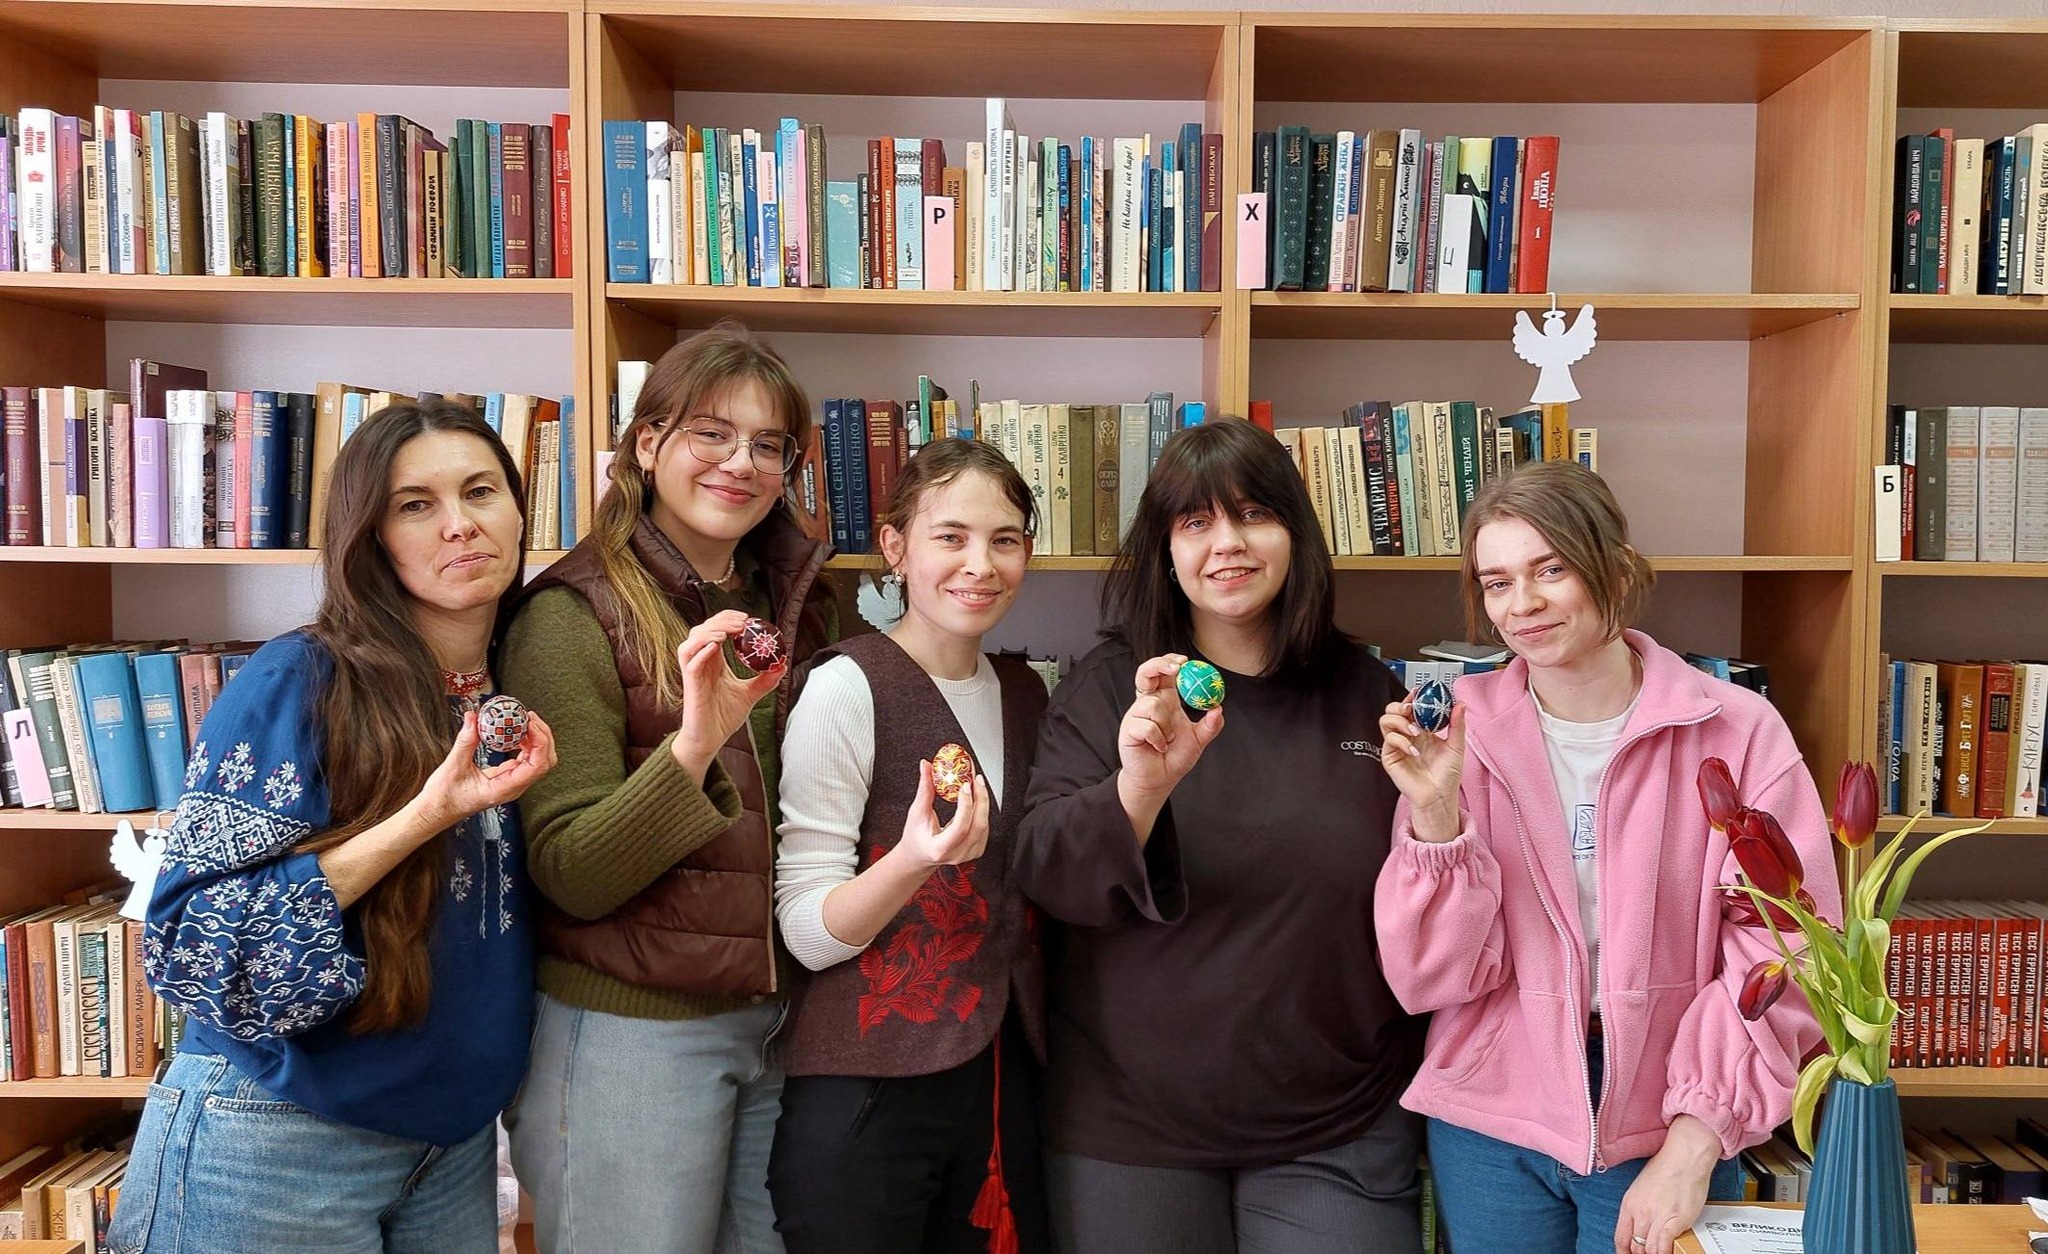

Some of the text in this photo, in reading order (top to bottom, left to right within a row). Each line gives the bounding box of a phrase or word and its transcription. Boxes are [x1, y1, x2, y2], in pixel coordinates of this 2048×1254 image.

[268, 140, 281, 205] КОВІНЬКА
[987, 128, 998, 198] САМОТНІСТЬ ПРОРОКА
[1208, 145, 1216, 186] РЯБОКЛЯЧ
[1912, 150, 1920, 162] НІЧ
[1335, 141, 1349, 223] СПРАВЖНЯ ЖІНКА
[1399, 166, 1411, 201] Химко
[1531, 180, 1540, 200] Іван
[2004, 166, 2012, 200] АЗАЗЕЛЬ
[298, 196, 308, 263] Андрій Кокотюха
[934, 208, 945, 224] Р
[1245, 203, 1259, 221] Х
[886, 232, 893, 241] ЗА
[1443, 247, 1454, 267] Ц
[1939, 245, 1947, 269] МАРК
[90, 407, 100, 480] ГРИГОРІЙ КОСИНКА
[1033, 424, 1043, 463] СКЛЯРЕНКО
[1057, 425, 1067, 465] СКЛЯРЕНКО
[830, 423, 846, 524] ІВАН СЕНЧЕНКО
[850, 422, 864, 524] ІВАН СЕНЧЕНКО
[1034, 468, 1040, 481] 3
[1058, 467, 1064, 479] 4
[1462, 437, 1474, 502] ІВАН ЧЕНДЕЙ
[1883, 476, 1894, 493] Б
[1369, 467, 1390, 545] В. ЧЕМЕРИС
[1388, 479, 1400, 522] ЧЕМЕРИС
[1392, 525, 1401, 535] В.
[192, 685, 203, 725] ПОЛТАВА
[15, 720, 31, 739] Л
[2022, 722, 2040, 770] КАКТУС
[76, 744, 84, 756] ДО
[1891, 740, 1902, 782] ГОЛОД
[60, 936, 70, 962] ЩИТИ
[111, 941, 121, 980] ПОЛІССЯ
[1907, 932, 1917, 953] ТЕСС
[1952, 932, 1961, 952] ТЕСС
[1963, 932, 1973, 952] ТЕСС
[1890, 934, 1902, 997] ТЕСС ҐЕРРІТСЕН
[1905, 955, 1917, 996] ҐЕРРІТСЕН
[1949, 953, 1961, 995] ҐЕРРІТСЕН
[1960, 953, 1973, 995] ҐЕРРІТСЕН
[1979, 933, 1991, 996] ТЕСС ҐЕРРІТСЕН
[1997, 933, 2009, 997] ТЕСС ҐЕРРІТСЕН
[2010, 931, 2022, 995] ТЕСС ҐЕРРІТСЕН
[135, 979, 144, 1011] МАНЯК
[1919, 934, 1933, 1054] ТЕСС ҐЕРРІТСЕН СМЕРТНИЦІ
[1934, 932, 1947, 1050] ТЕСС ҐЕРРІТСЕН ПОСЛУХАЙ МЕНЕ
[2023, 931, 2038, 1049] ТЕСС ҐЕРРІТСЕН ПОМЕРТИ ЗНОВУ
[1961, 1004, 1970, 1023] ЗНАЮ
[135, 1015, 145, 1069] ВОЛОДИМИР
[1960, 1024, 1969, 1049] СЕКРЕТ
